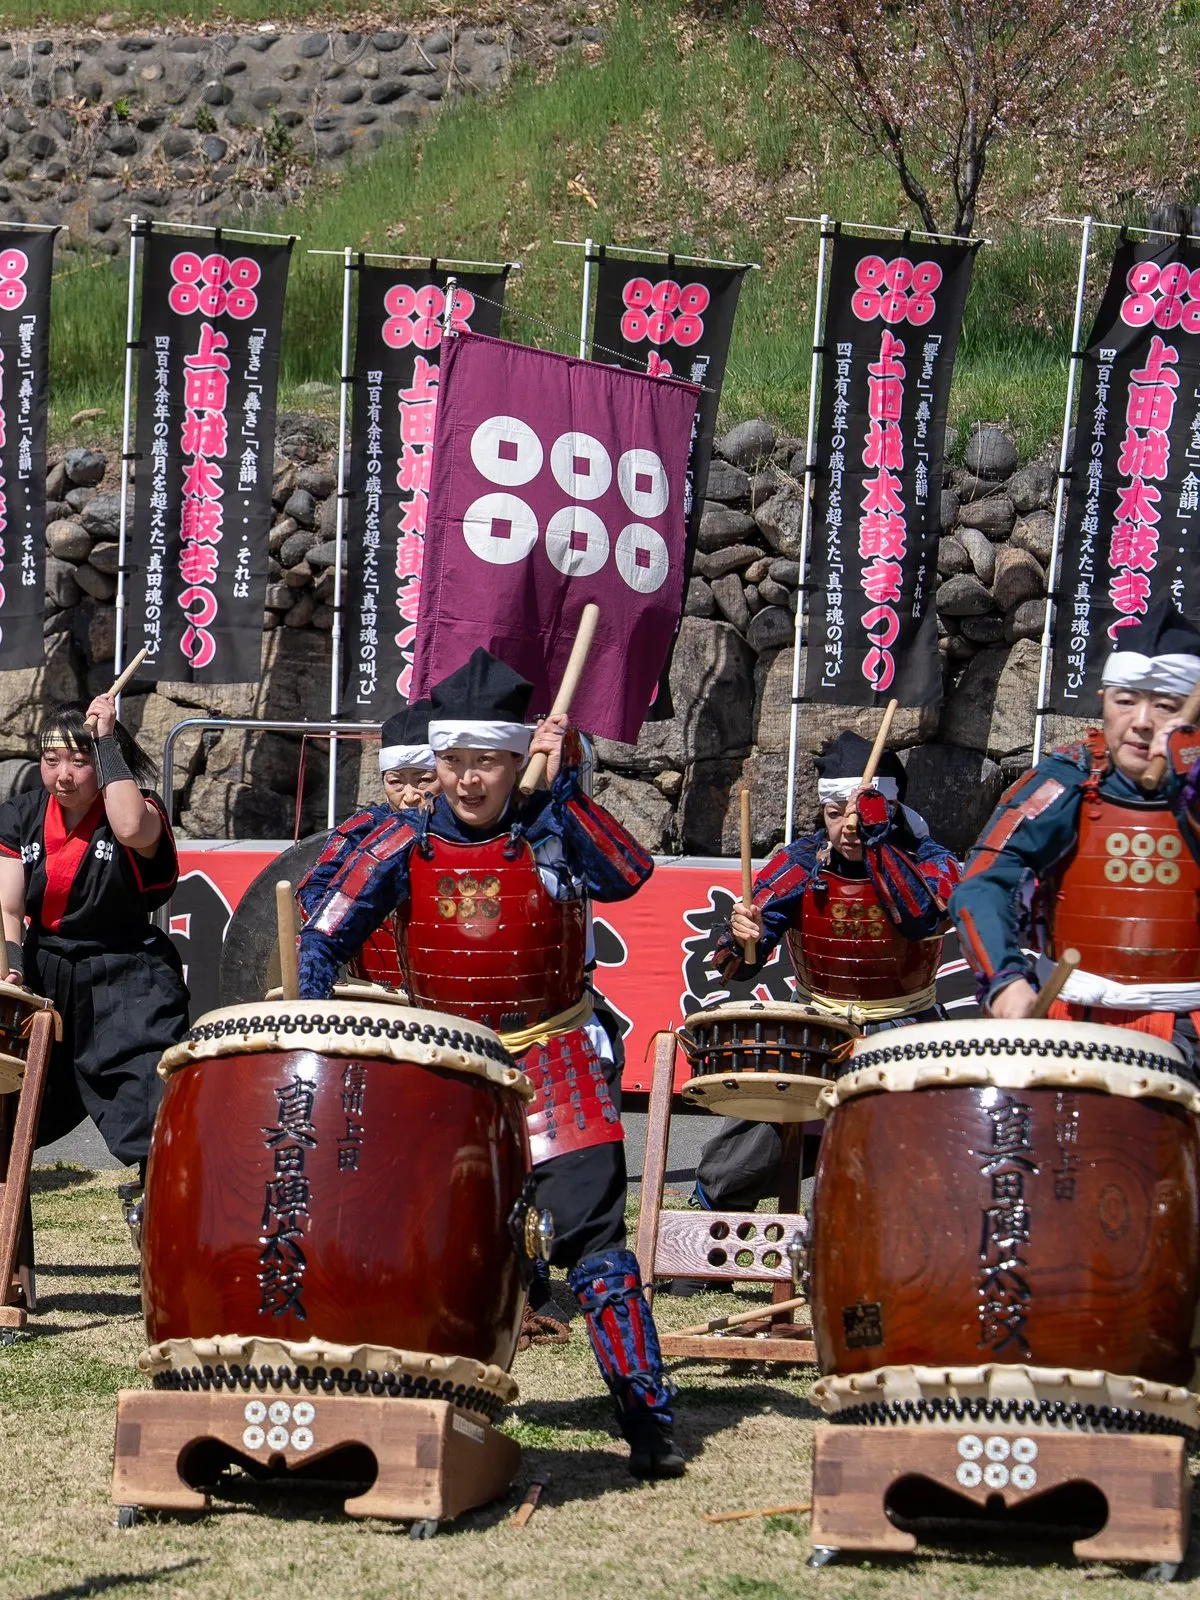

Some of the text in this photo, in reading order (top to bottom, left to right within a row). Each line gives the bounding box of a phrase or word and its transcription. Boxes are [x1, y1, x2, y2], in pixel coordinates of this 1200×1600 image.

[178, 322, 231, 669] 上田城太鼓まつり
[858, 328, 907, 692] 上田城太鼓まつり
[257, 1074, 319, 1321] 真田陣太鼓
